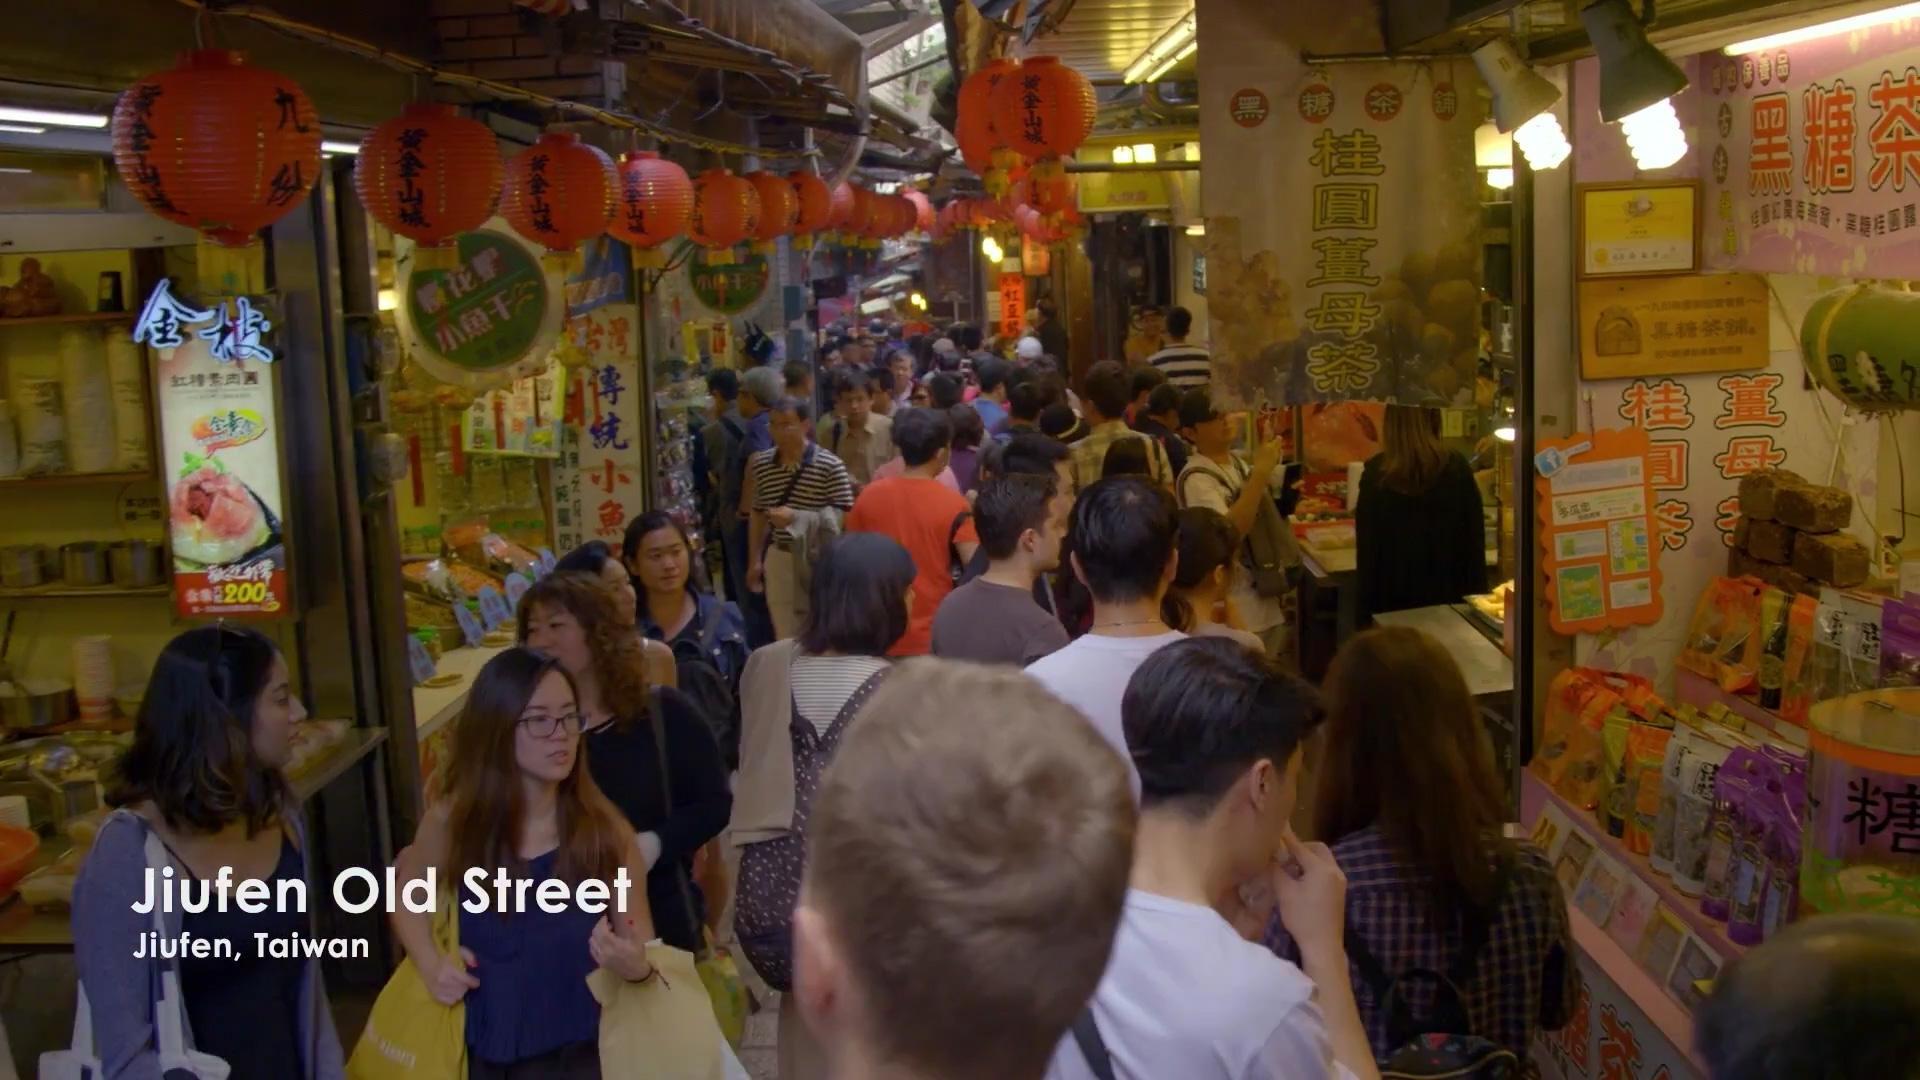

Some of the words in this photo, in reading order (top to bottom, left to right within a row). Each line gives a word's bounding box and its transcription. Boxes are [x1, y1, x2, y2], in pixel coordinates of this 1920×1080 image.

[1748, 64, 1920, 198] 黑糖茶
[1304, 127, 1386, 394] 桂圓薑母茶
